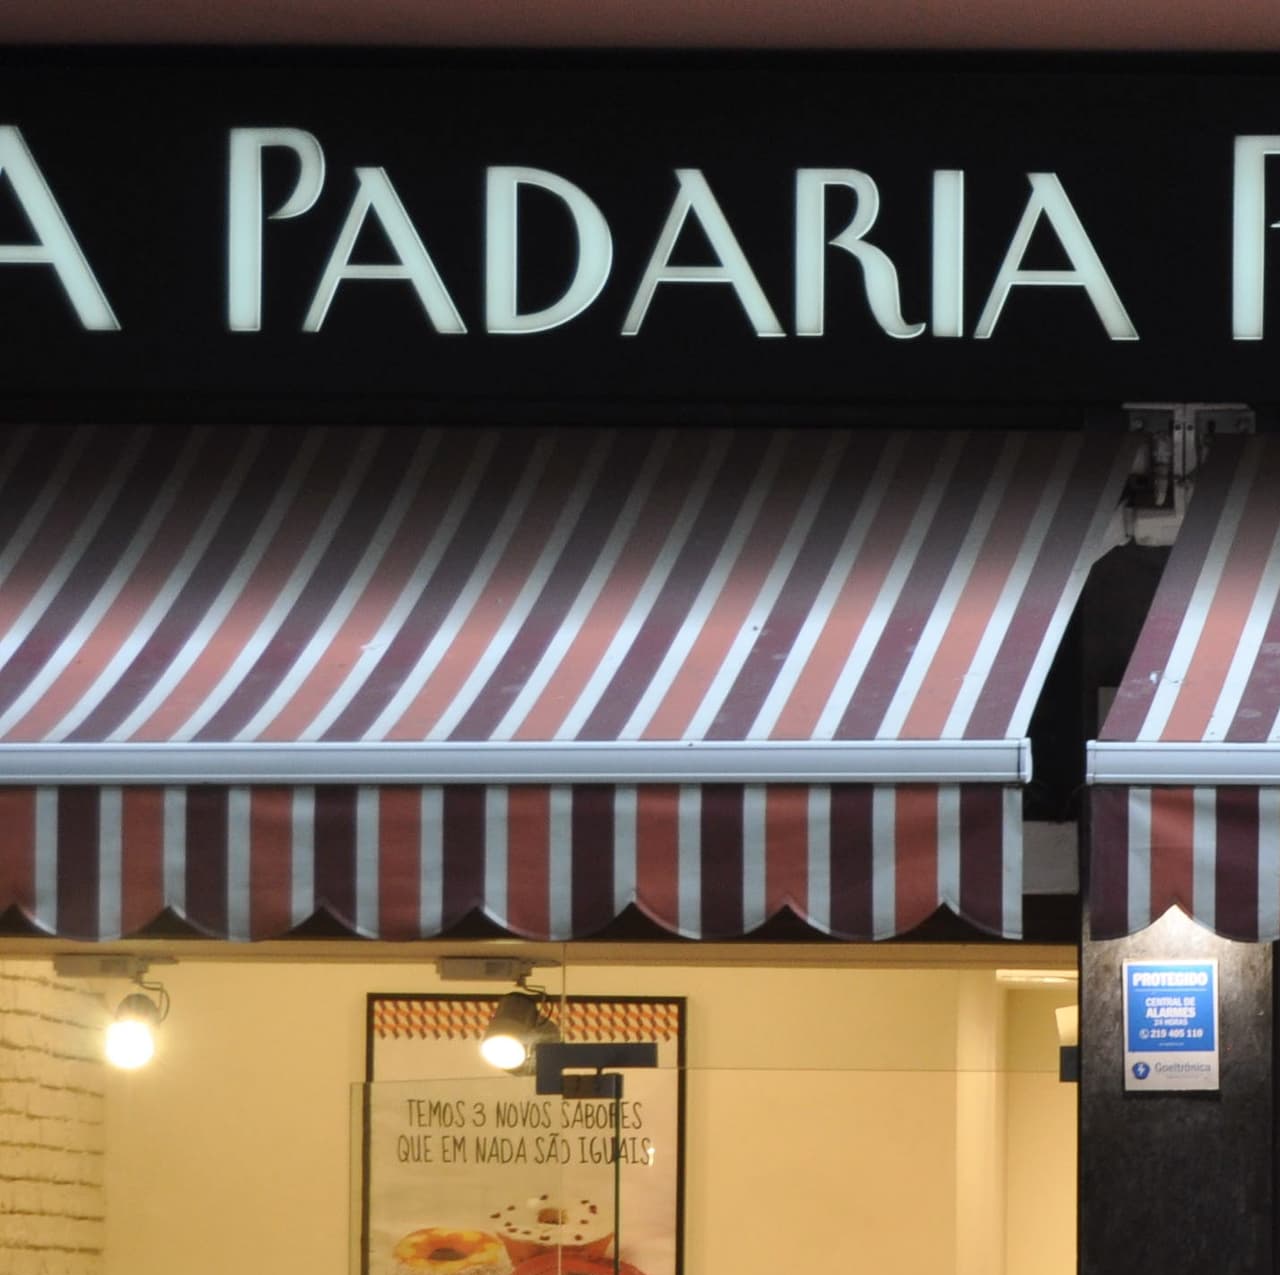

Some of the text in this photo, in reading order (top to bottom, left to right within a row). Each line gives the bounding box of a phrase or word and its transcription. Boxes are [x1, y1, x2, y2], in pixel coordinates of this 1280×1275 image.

[0, 125, 122, 331] A
[228, 127, 1140, 341] PADARIA
[1132, 972, 1208, 987] PROTEGIDO
[1145, 1007, 1196, 1018] ALARMES
[1183, 996, 1195, 1006] DE
[407, 1099, 465, 1128] TEMOS
[472, 1102, 487, 1128] 3
[496, 1099, 552, 1130] NOVOS
[397, 1134, 433, 1163] QUE
[442, 1135, 466, 1163] EM
[475, 1136, 528, 1164] NADA
[579, 1136, 651, 1165] IGUAIS
